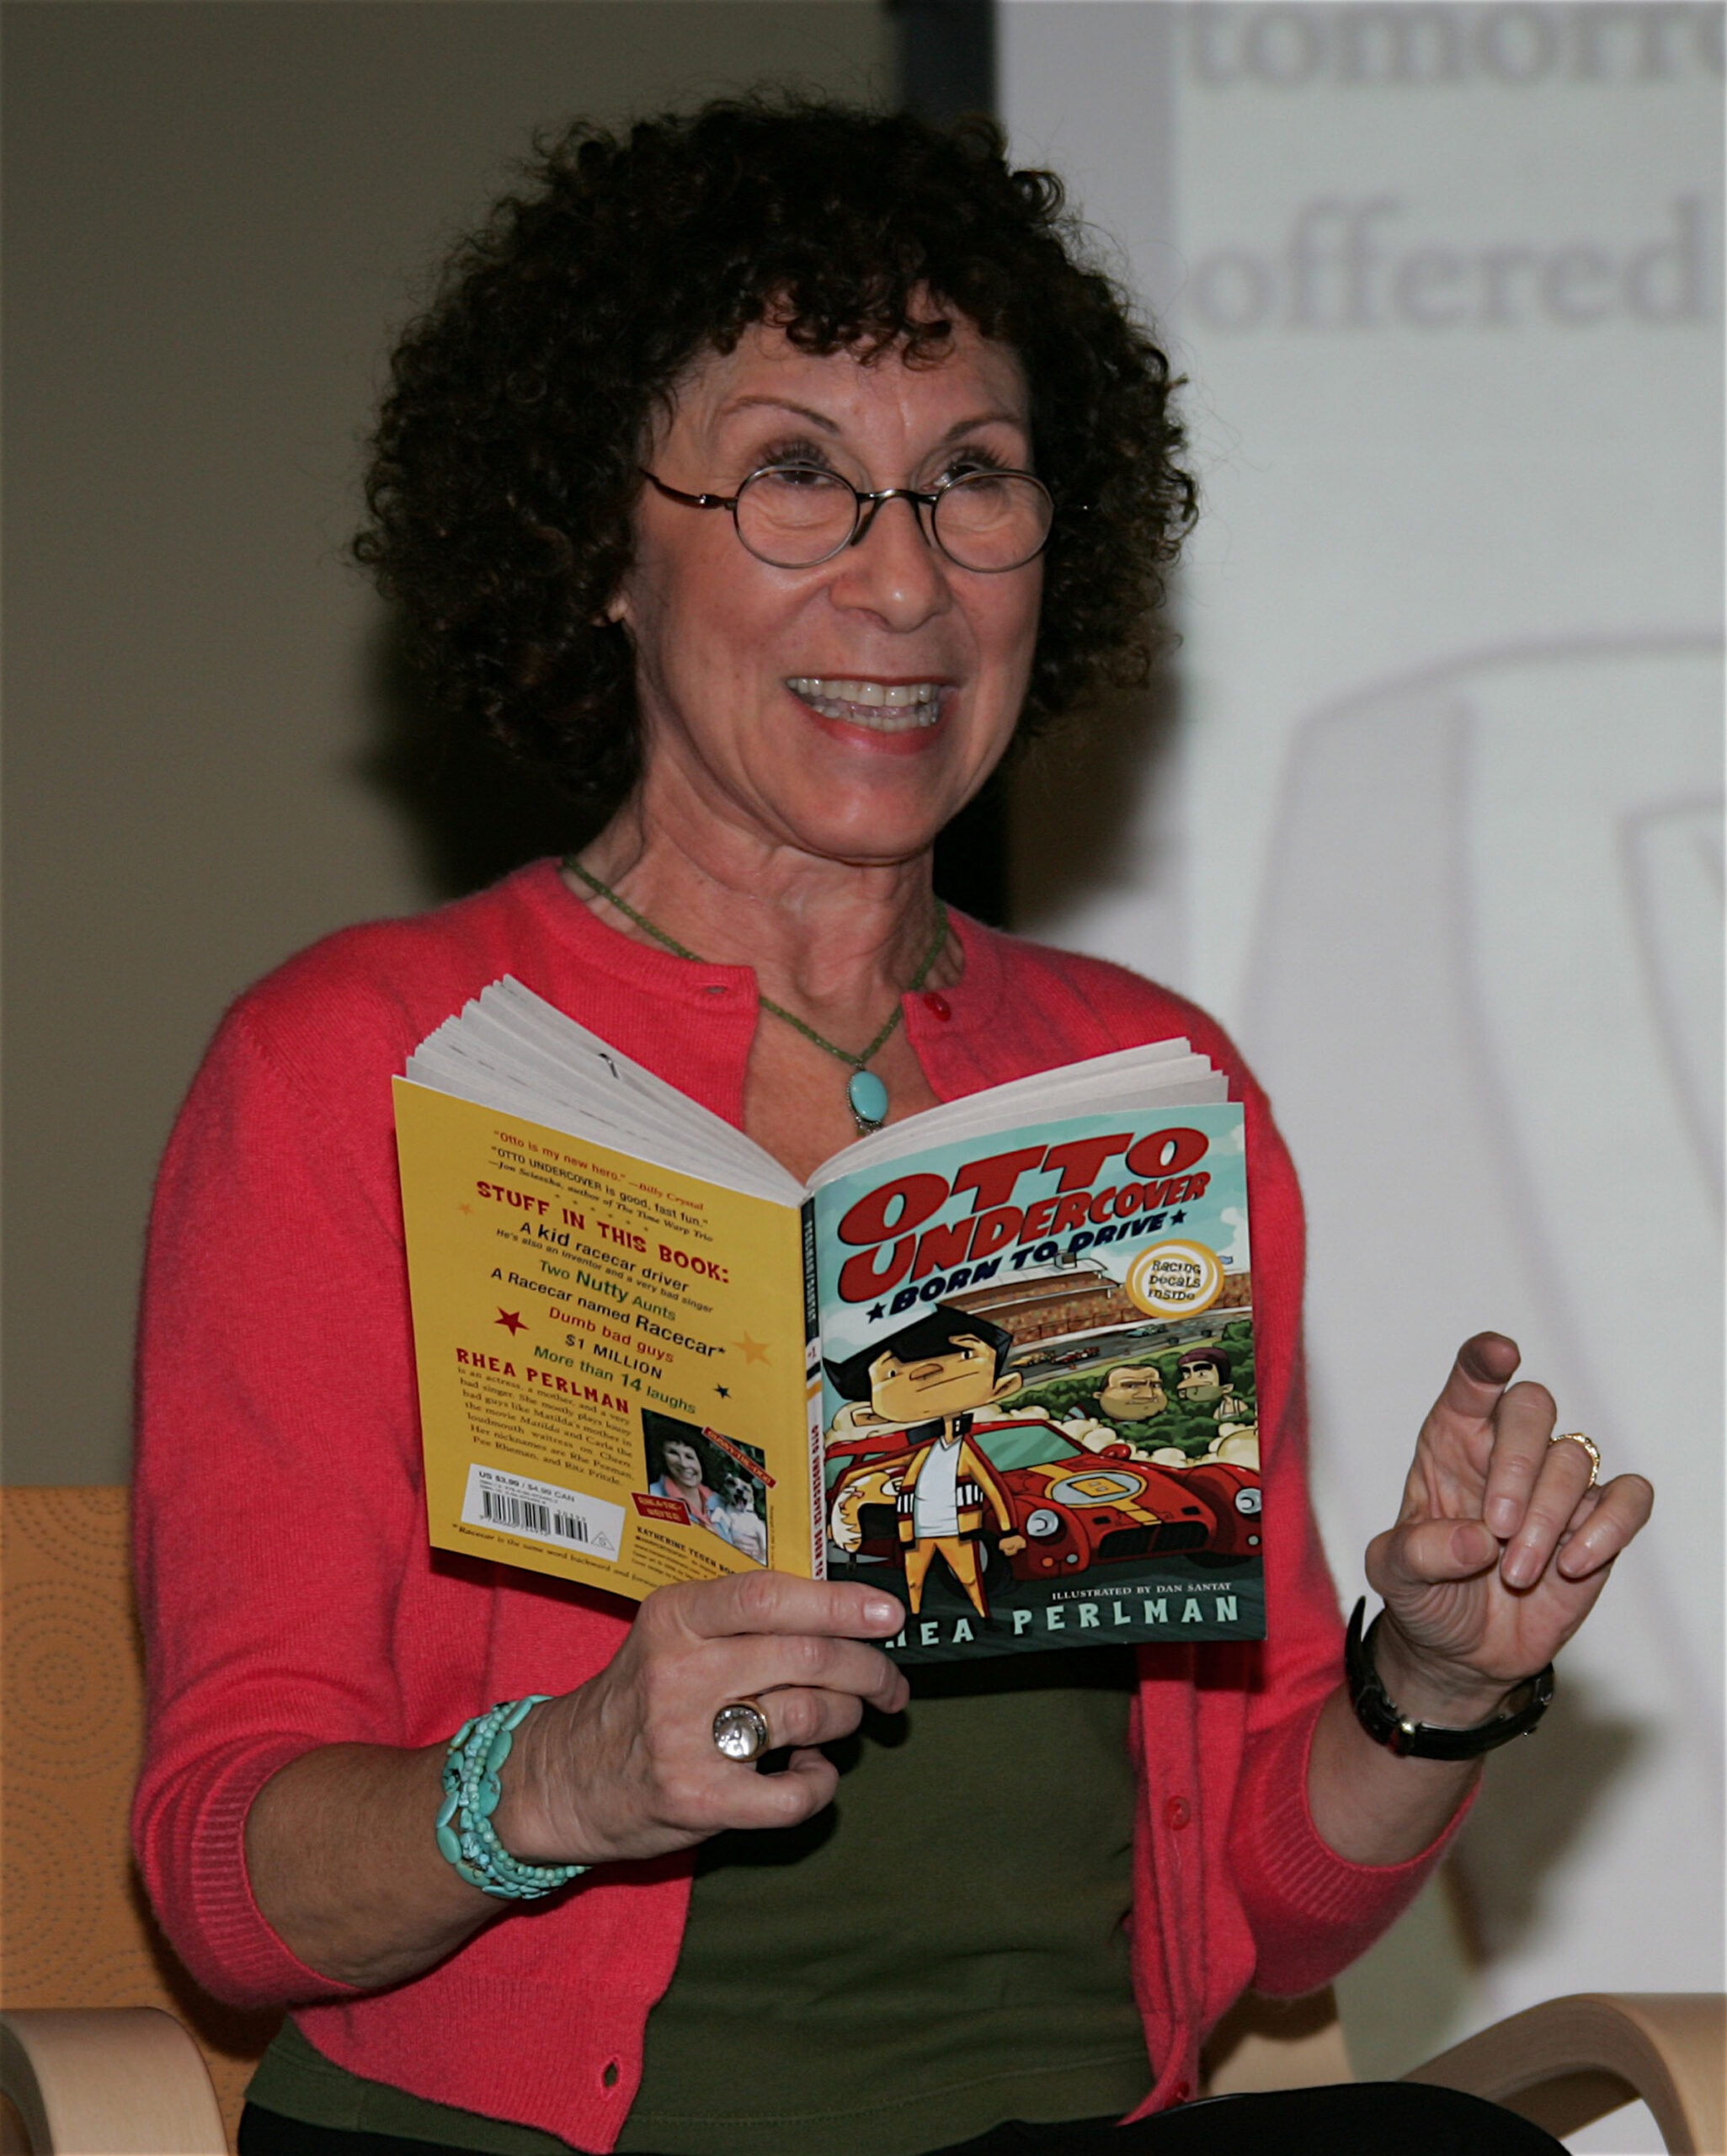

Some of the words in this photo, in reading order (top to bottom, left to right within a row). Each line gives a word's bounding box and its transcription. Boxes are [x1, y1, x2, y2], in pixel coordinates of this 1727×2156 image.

[1190, 192, 1709, 332] offered
[528, 1141, 538, 1152] is
[542, 1148, 559, 1161] my
[564, 1155, 588, 1169] new
[667, 1193, 704, 1210] Crystal
[529, 1158, 601, 1191] UNDERCOVER
[605, 1185, 616, 1196] is
[655, 1203, 676, 1218] fast
[837, 1127, 1209, 1246] OTTO
[476, 1181, 550, 1215] STUFF
[562, 1208, 585, 1230] IN
[597, 1221, 648, 1253] THIS
[658, 1244, 729, 1284] BOOK:
[568, 1186, 600, 1201] author
[603, 1198, 614, 1208] of
[616, 1202, 633, 1214] The
[637, 1209, 660, 1223] Time
[664, 1219, 690, 1235] Warp
[694, 1229, 713, 1242] Trio
[837, 1171, 1211, 1303] UNDERCOVER
[520, 1222, 531, 1235] A
[538, 1224, 570, 1246] kid
[575, 1241, 637, 1272] racecar
[642, 1267, 690, 1293] driver
[522, 1237, 542, 1249] also
[546, 1246, 558, 1255] an
[562, 1250, 602, 1271] inventor
[605, 1267, 624, 1278] and
[637, 1280, 658, 1293] very
[660, 1288, 680, 1300] bad
[681, 1295, 714, 1314] singer
[888, 1256, 1004, 1315] BORN
[1010, 1241, 1058, 1270] TO
[1068, 1212, 1169, 1253] DRIVE
[491, 1267, 502, 1280] A
[509, 1272, 573, 1302] Racecar
[578, 1297, 630, 1323] named
[541, 1259, 570, 1280] Two
[577, 1269, 629, 1303] Nutty
[633, 1295, 676, 1321] Aunts
[549, 1306, 596, 1332] Dumb
[602, 1326, 631, 1346] bad
[637, 1342, 674, 1364] guys
[566, 1333, 584, 1350] $1
[594, 1343, 663, 1380] MILLION
[456, 1348, 516, 1377] RHEA
[526, 1367, 630, 1414] PERLMAN
[534, 1346, 574, 1367] More
[579, 1361, 613, 1381] than
[621, 1374, 642, 1391] 14
[647, 1386, 696, 1414] laughs
[811, 1424, 819, 1454] OTTO
[478, 1471, 493, 1481] US
[554, 1492, 574, 1502] CAN
[637, 1526, 686, 1550] KATHERINE
[814, 1529, 824, 1560] BORN
[1053, 1587, 1132, 1600] ILLUSTRATED
[1137, 1585, 1151, 1594] BY
[1156, 1584, 1182, 1593] DAN
[1187, 1582, 1232, 1593] SANTAT
[885, 1618, 974, 1648] EA
[1012, 1596, 1238, 1636] PERLMAN
